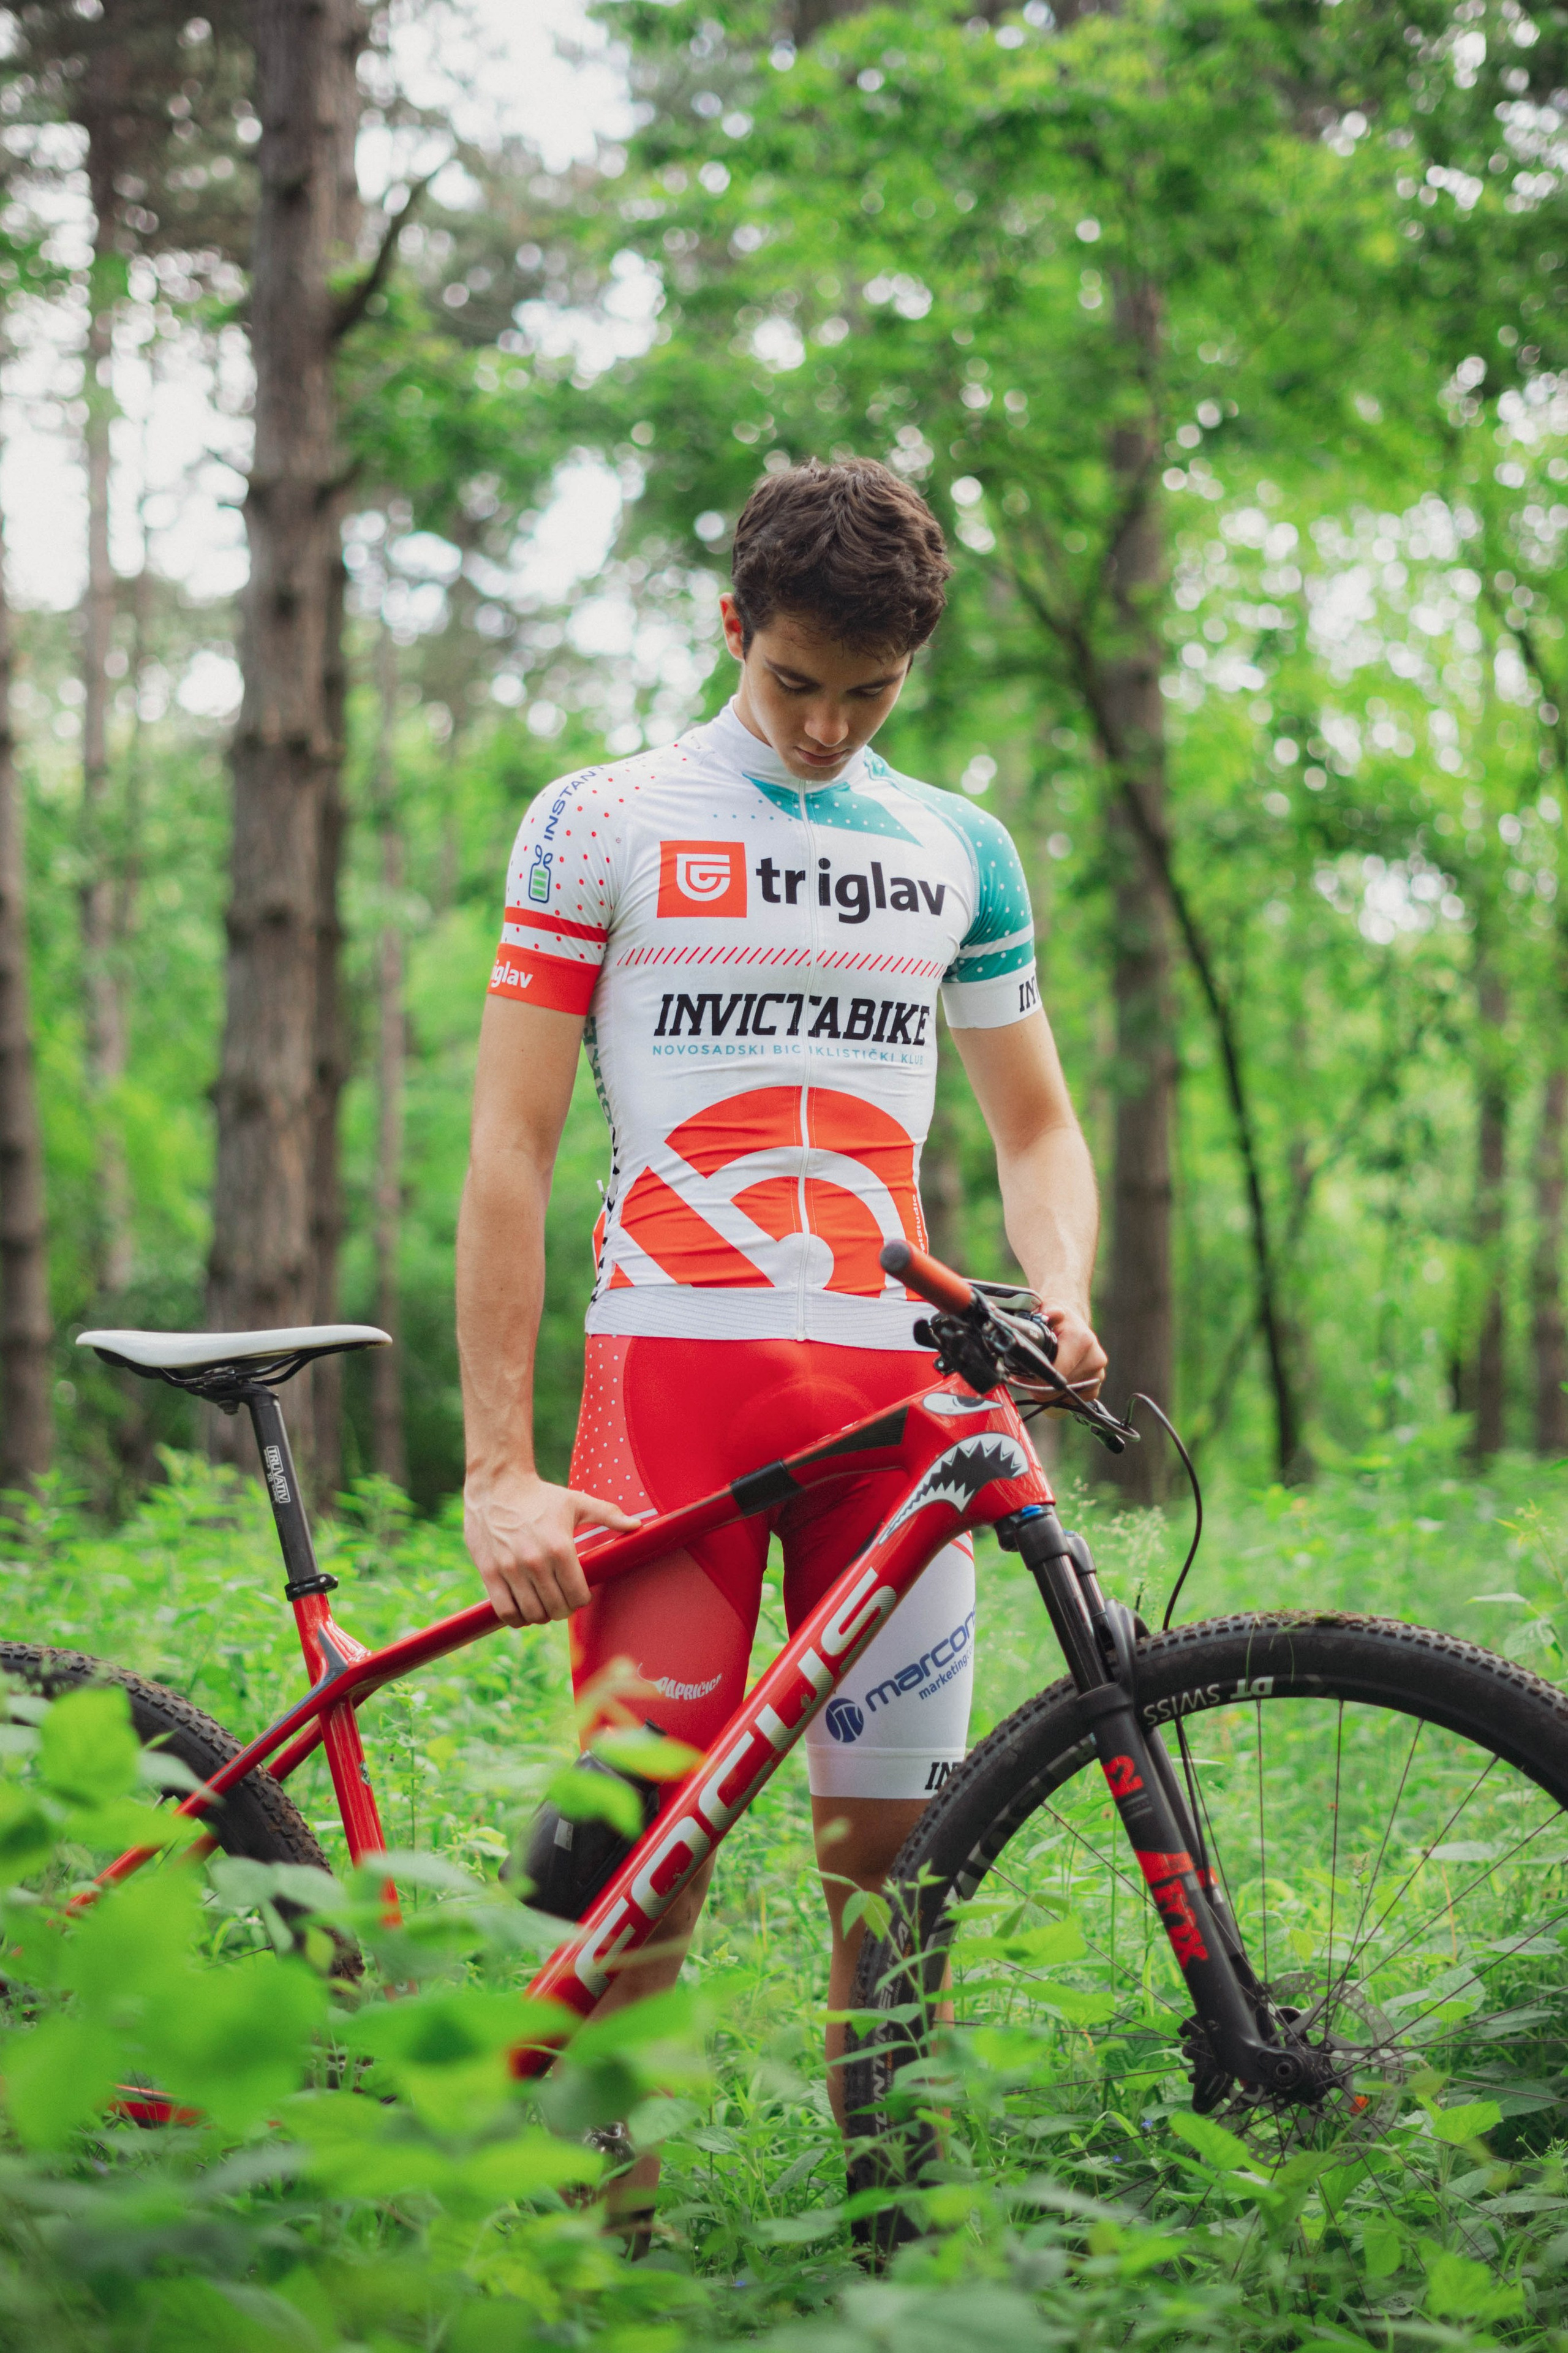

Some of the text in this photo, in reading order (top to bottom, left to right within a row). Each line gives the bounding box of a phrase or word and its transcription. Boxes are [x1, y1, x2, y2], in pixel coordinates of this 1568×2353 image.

[756, 857, 945, 924] triglav
[654, 993, 930, 1046] INVICTABIKE
[1019, 976, 1039, 1013] IN
[652, 1043, 765, 1057] NOVOSADSKI
[266, 1445, 290, 1503] TRUVATIV
[1143, 1677, 1274, 1726] DT SWISS
[575, 1567, 897, 1998] FOCUS
[925, 1762, 962, 1790] IN
